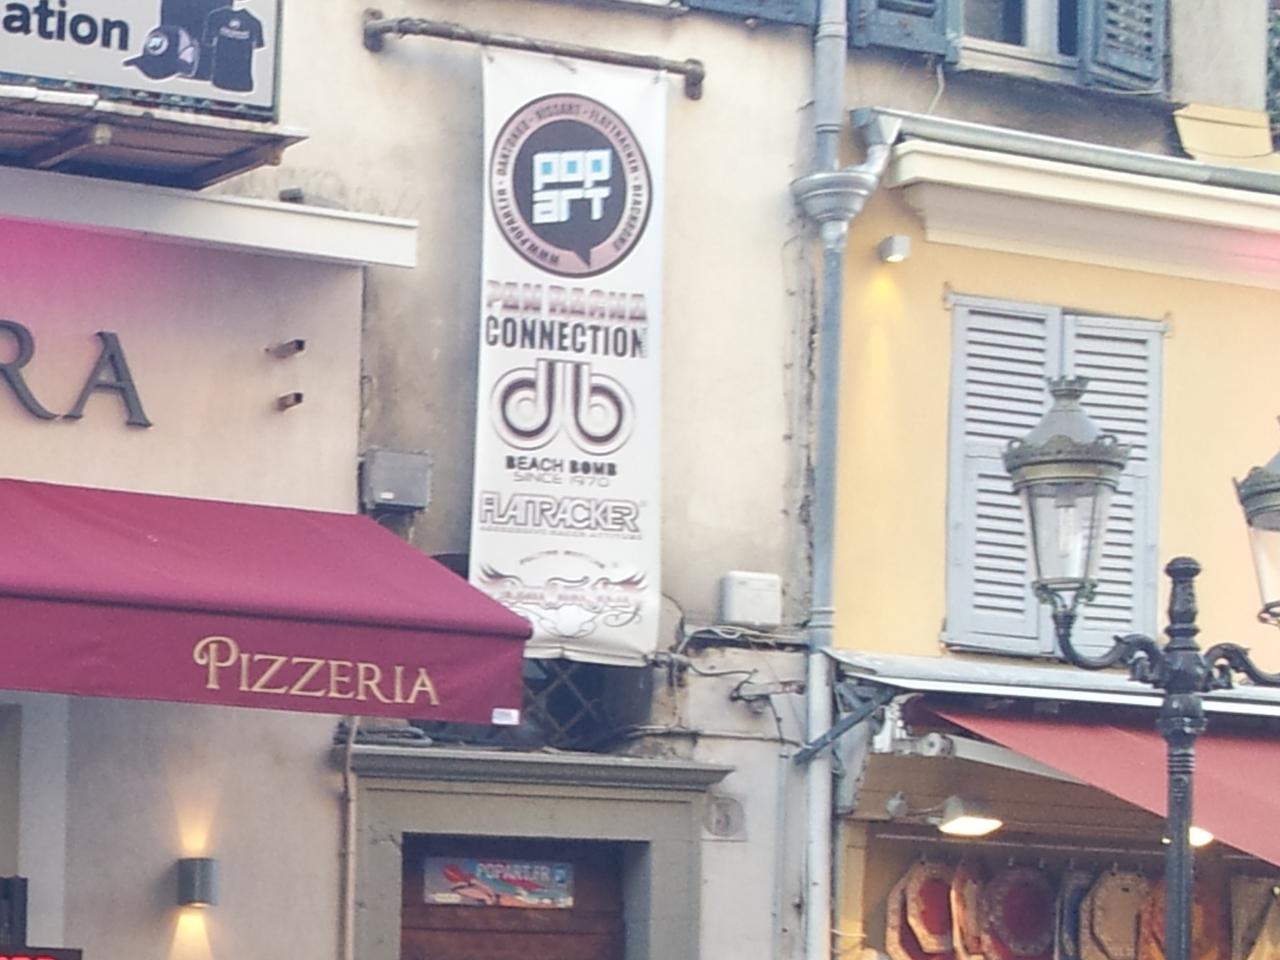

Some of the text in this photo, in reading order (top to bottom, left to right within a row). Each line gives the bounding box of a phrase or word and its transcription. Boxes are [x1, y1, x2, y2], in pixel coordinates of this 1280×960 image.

[485, 315, 644, 359] CONNECTION
[505, 455, 618, 478] BEACH BOMB
[192, 634, 440, 706] PIZZERIA
